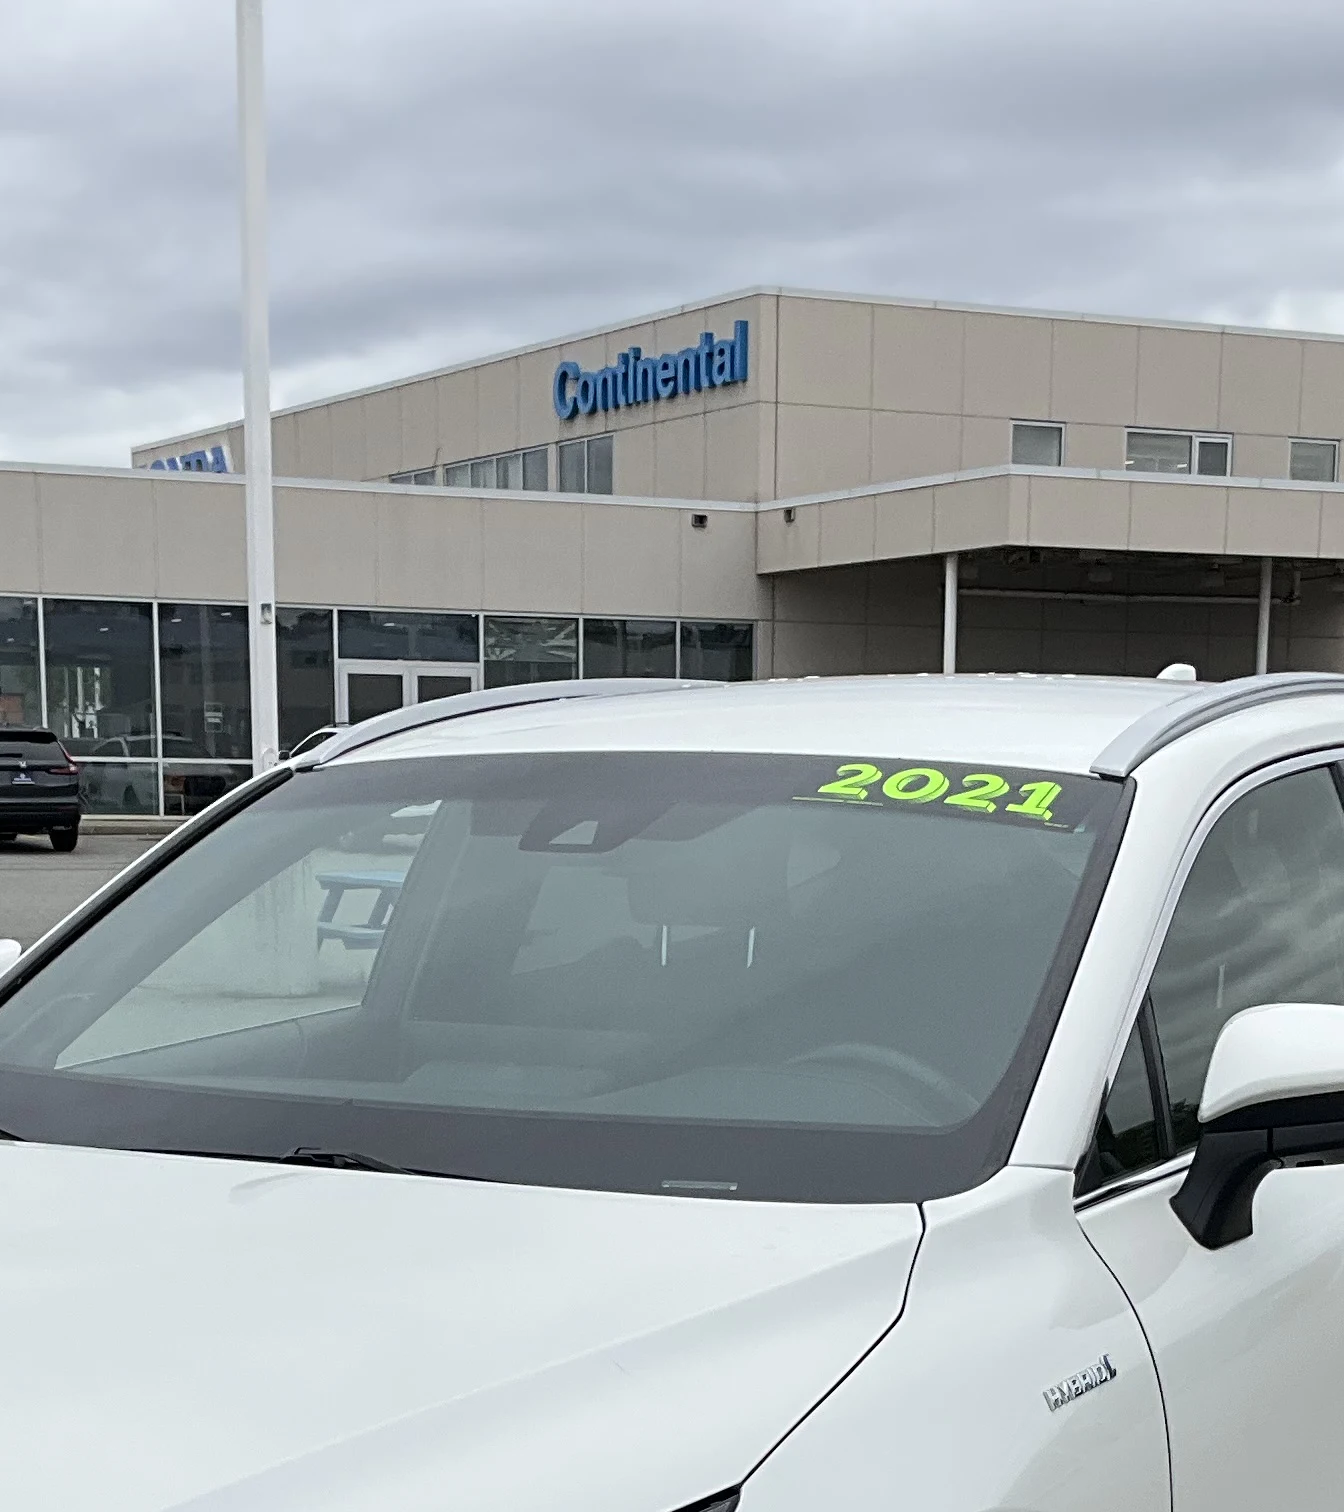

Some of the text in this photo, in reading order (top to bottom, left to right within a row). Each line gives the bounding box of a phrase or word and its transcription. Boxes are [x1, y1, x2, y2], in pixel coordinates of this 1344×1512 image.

[553, 319, 749, 420] Continental
[817, 763, 1062, 821] 2021
[1042, 1362, 1110, 1412] HYBRID
